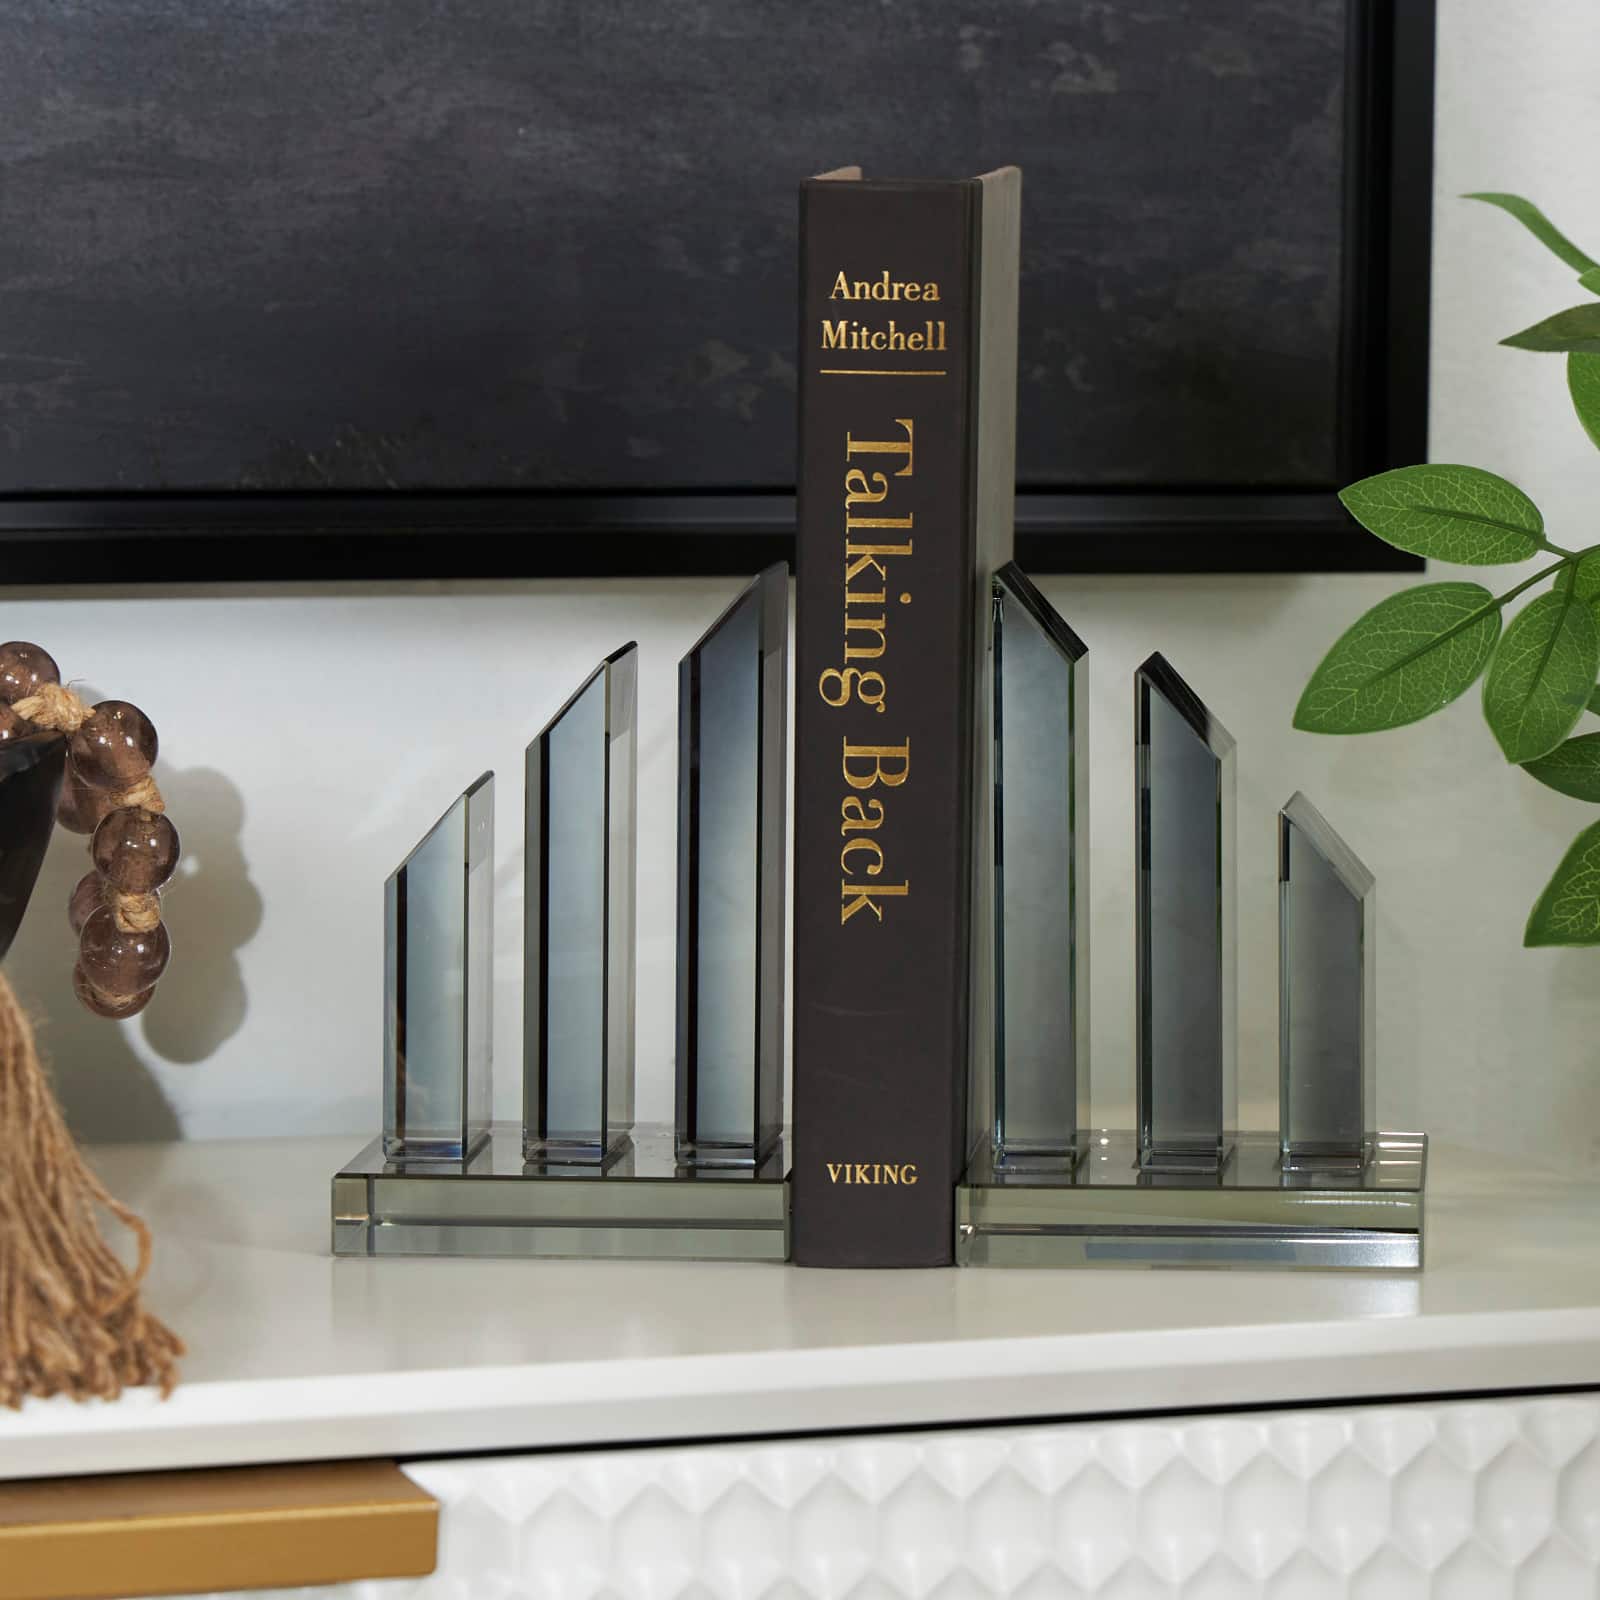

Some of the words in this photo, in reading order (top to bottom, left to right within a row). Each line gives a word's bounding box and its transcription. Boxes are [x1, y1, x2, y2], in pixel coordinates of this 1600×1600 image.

[831, 270, 940, 303] Andrea
[821, 319, 947, 352] Mitchell
[818, 418, 916, 714] Talking
[838, 736, 911, 925] Back
[826, 1163, 919, 1186] VIKING
